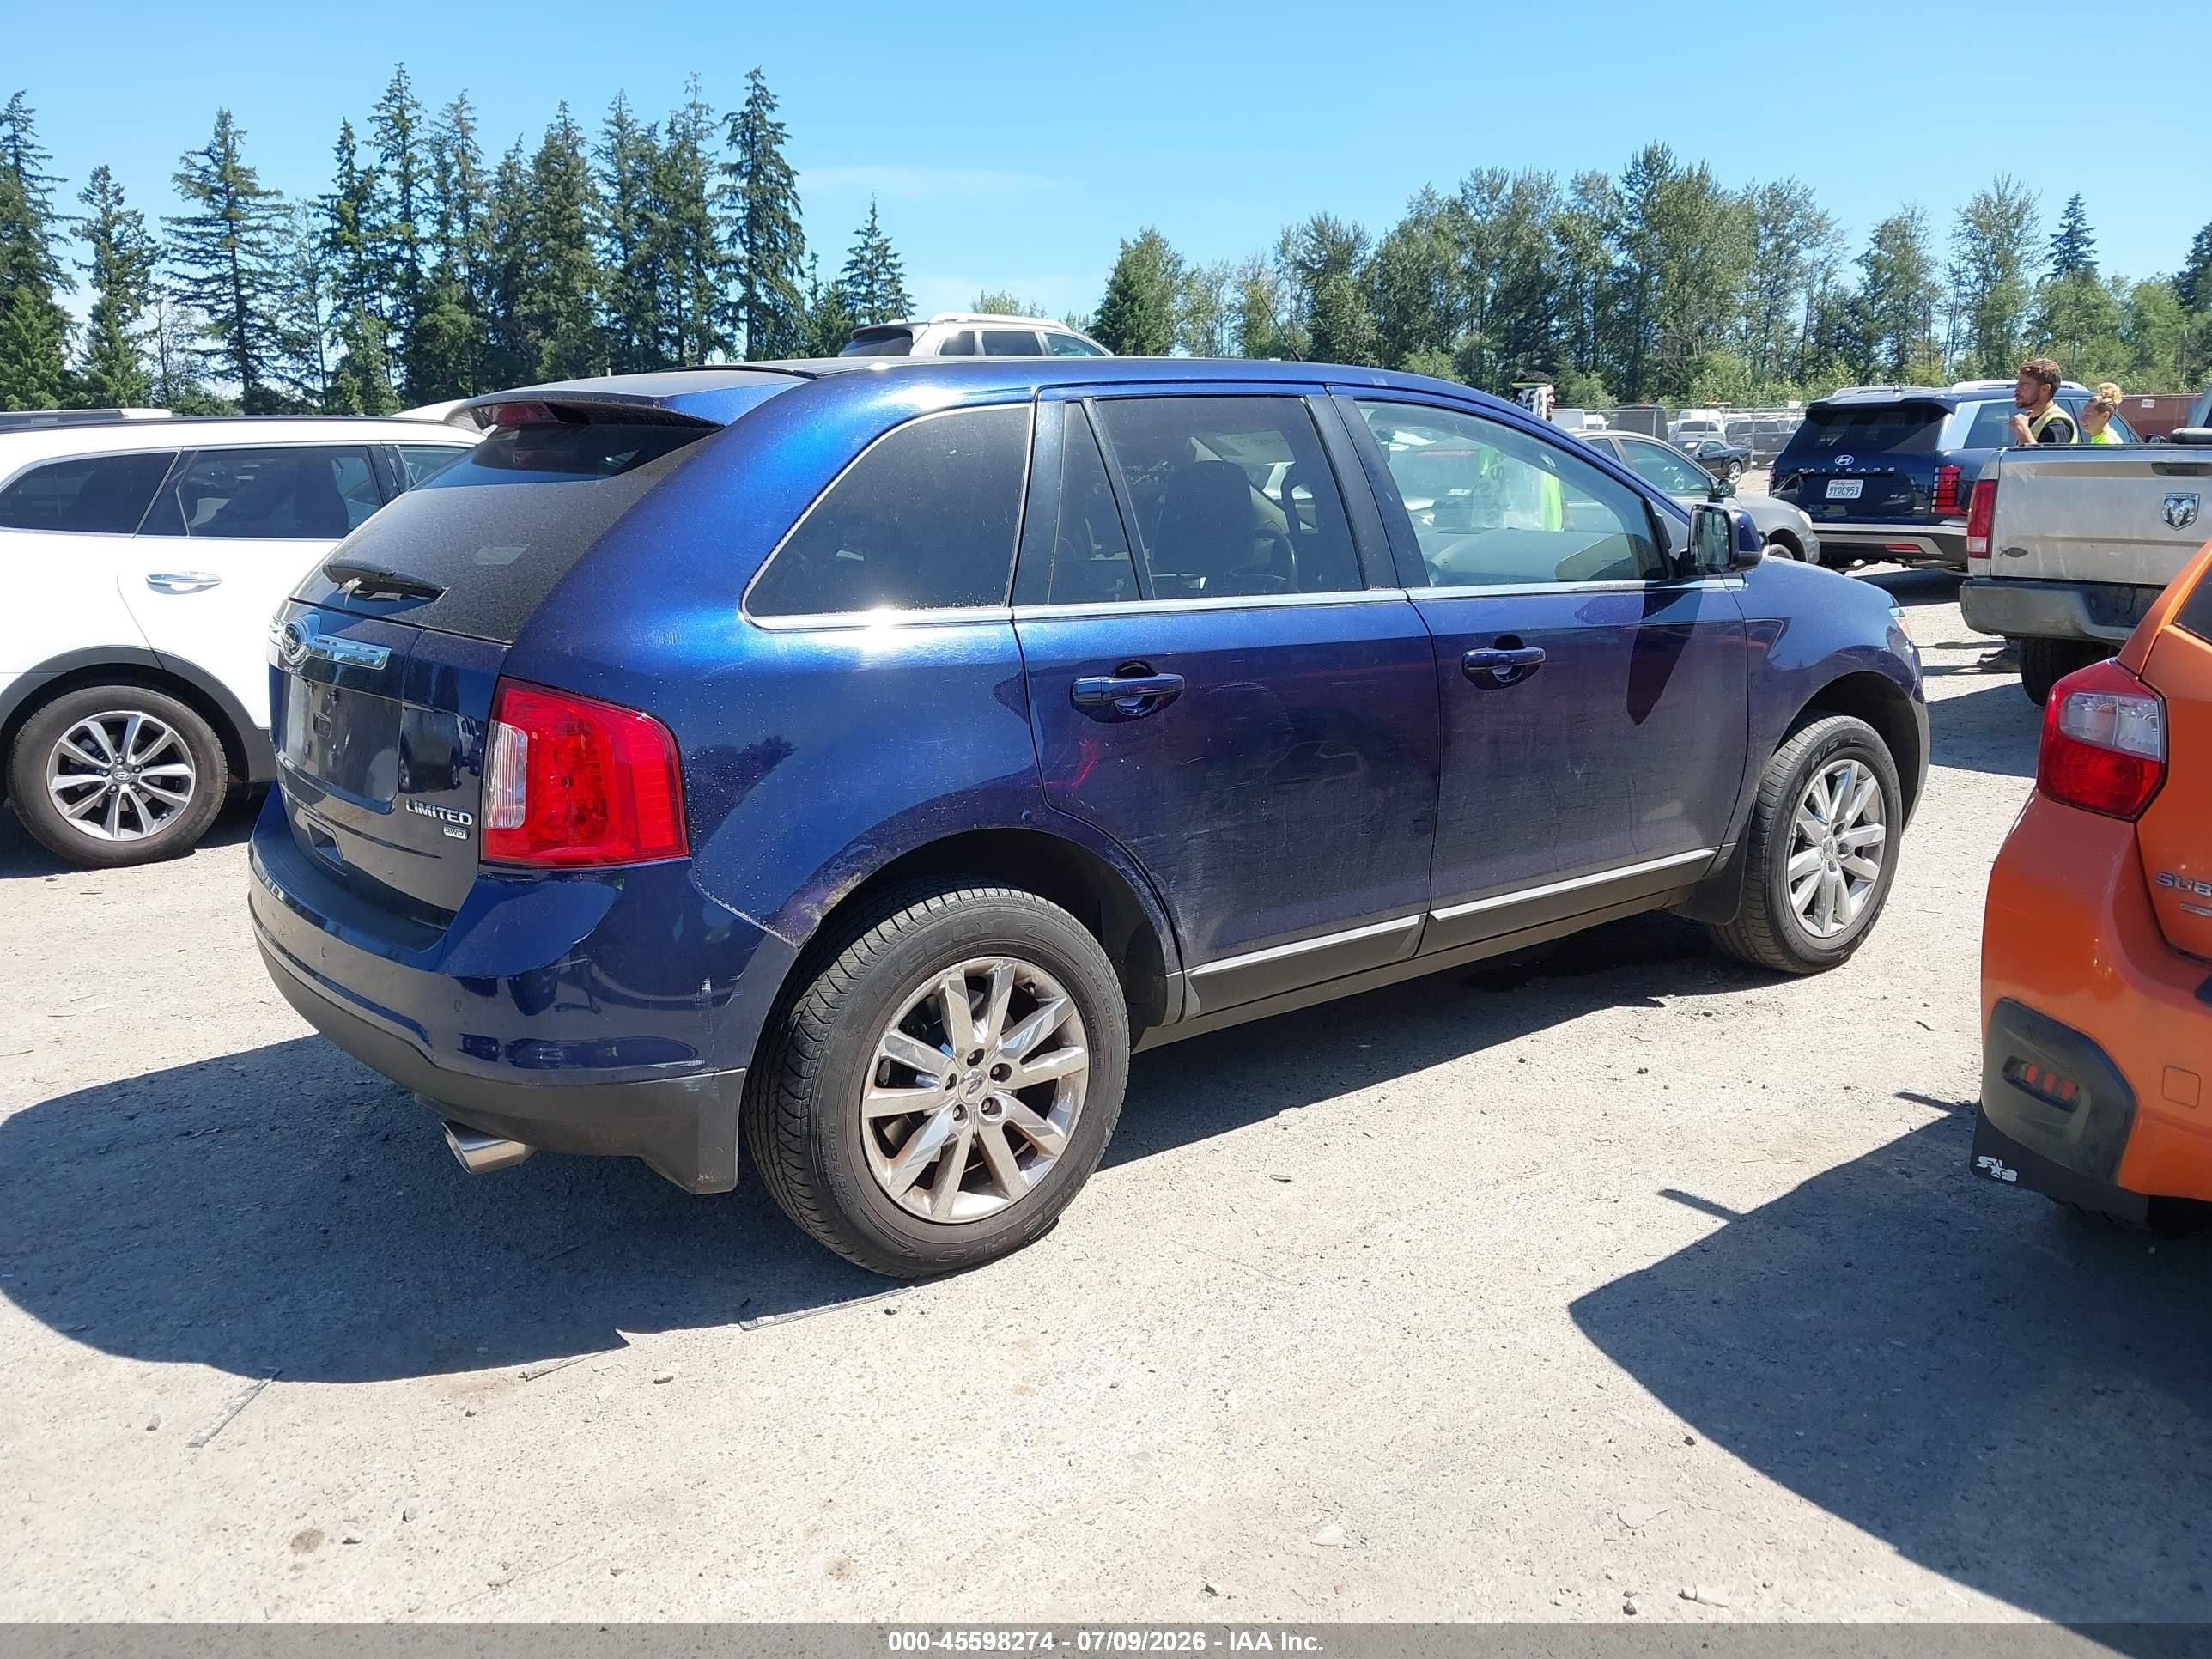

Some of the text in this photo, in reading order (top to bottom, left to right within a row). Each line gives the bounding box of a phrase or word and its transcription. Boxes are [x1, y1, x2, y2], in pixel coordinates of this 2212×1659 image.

[405, 799, 474, 826] LIMITED
[445, 827, 465, 837] AWD
[880, 921, 998, 994] KELLY
